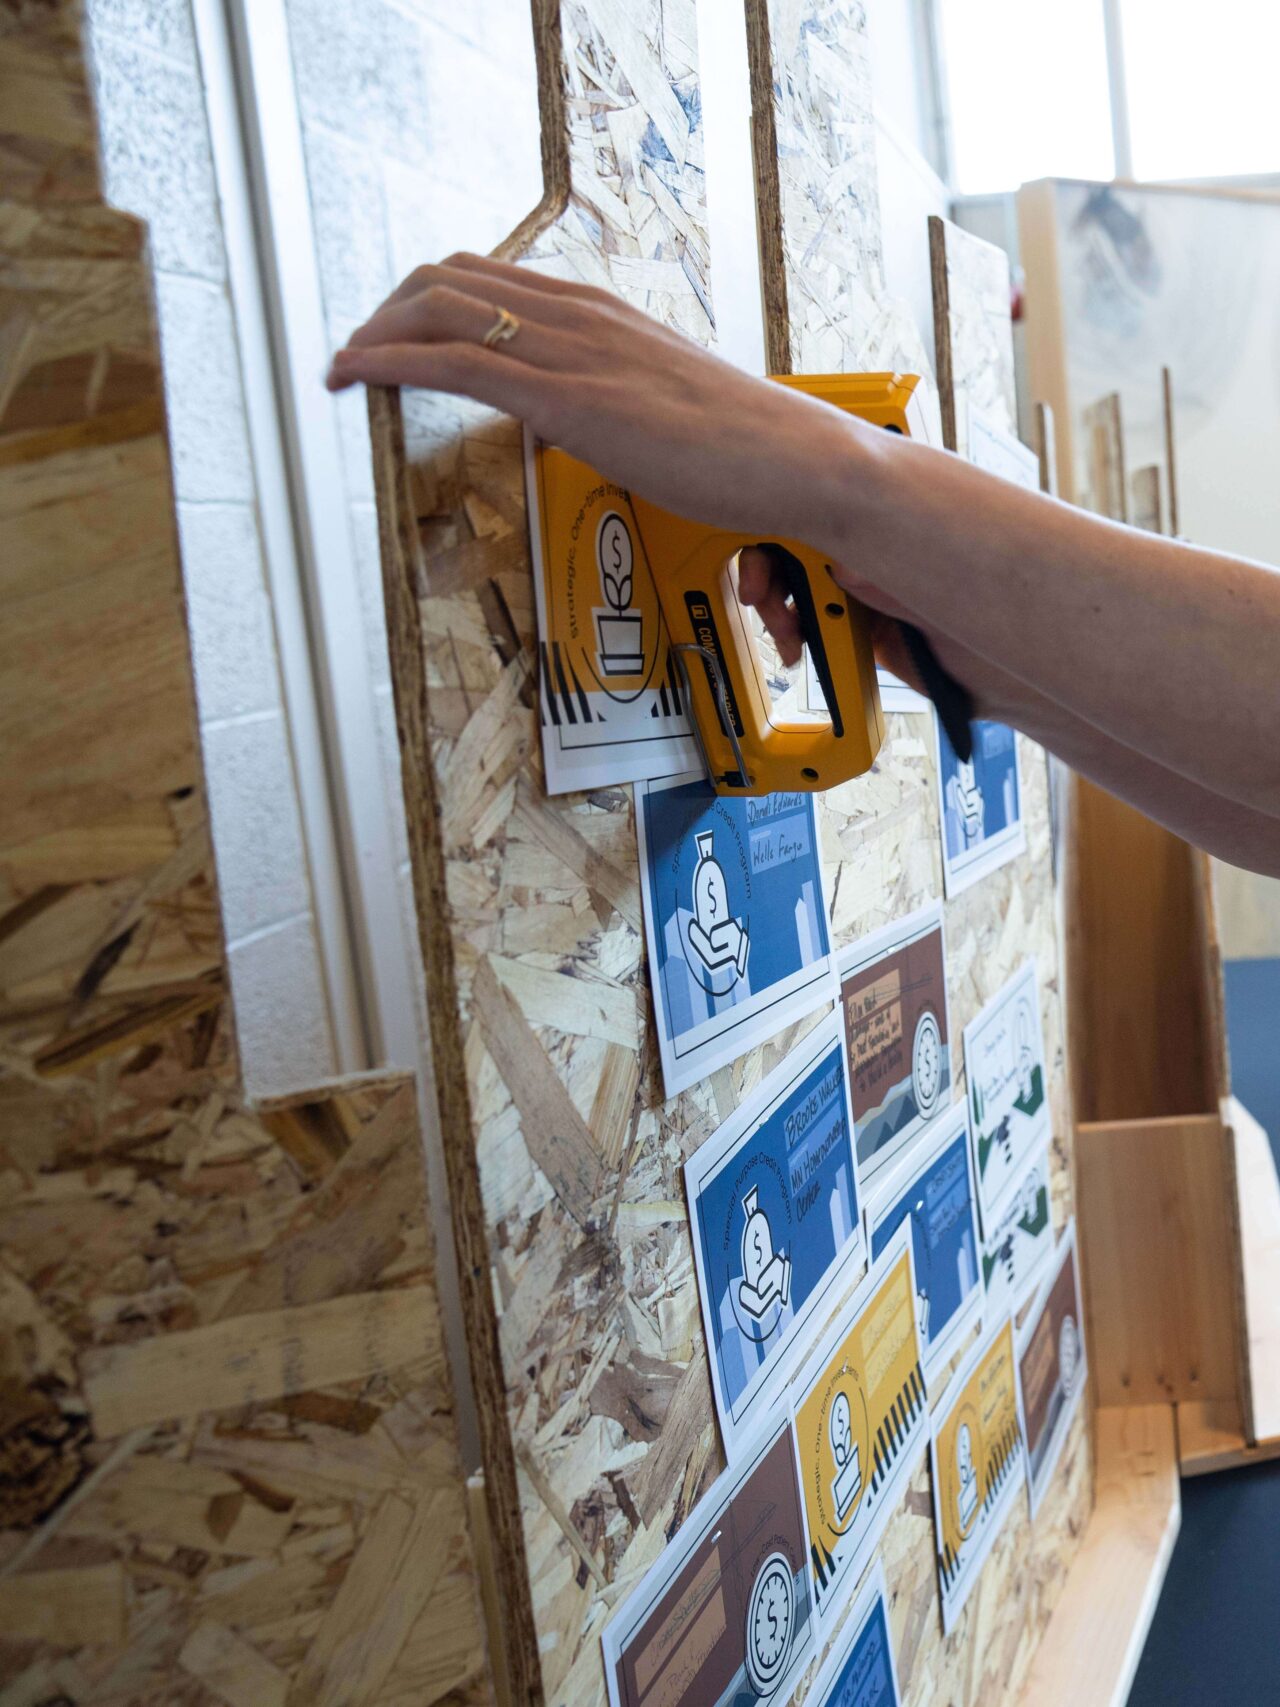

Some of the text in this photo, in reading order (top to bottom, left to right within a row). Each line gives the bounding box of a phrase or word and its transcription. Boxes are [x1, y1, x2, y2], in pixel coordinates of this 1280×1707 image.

[753, 840, 774, 867] Wells
[734, 1154, 759, 1190] Purpose
[758, 1151, 778, 1175] Credit
[775, 1167, 793, 1225] Program
